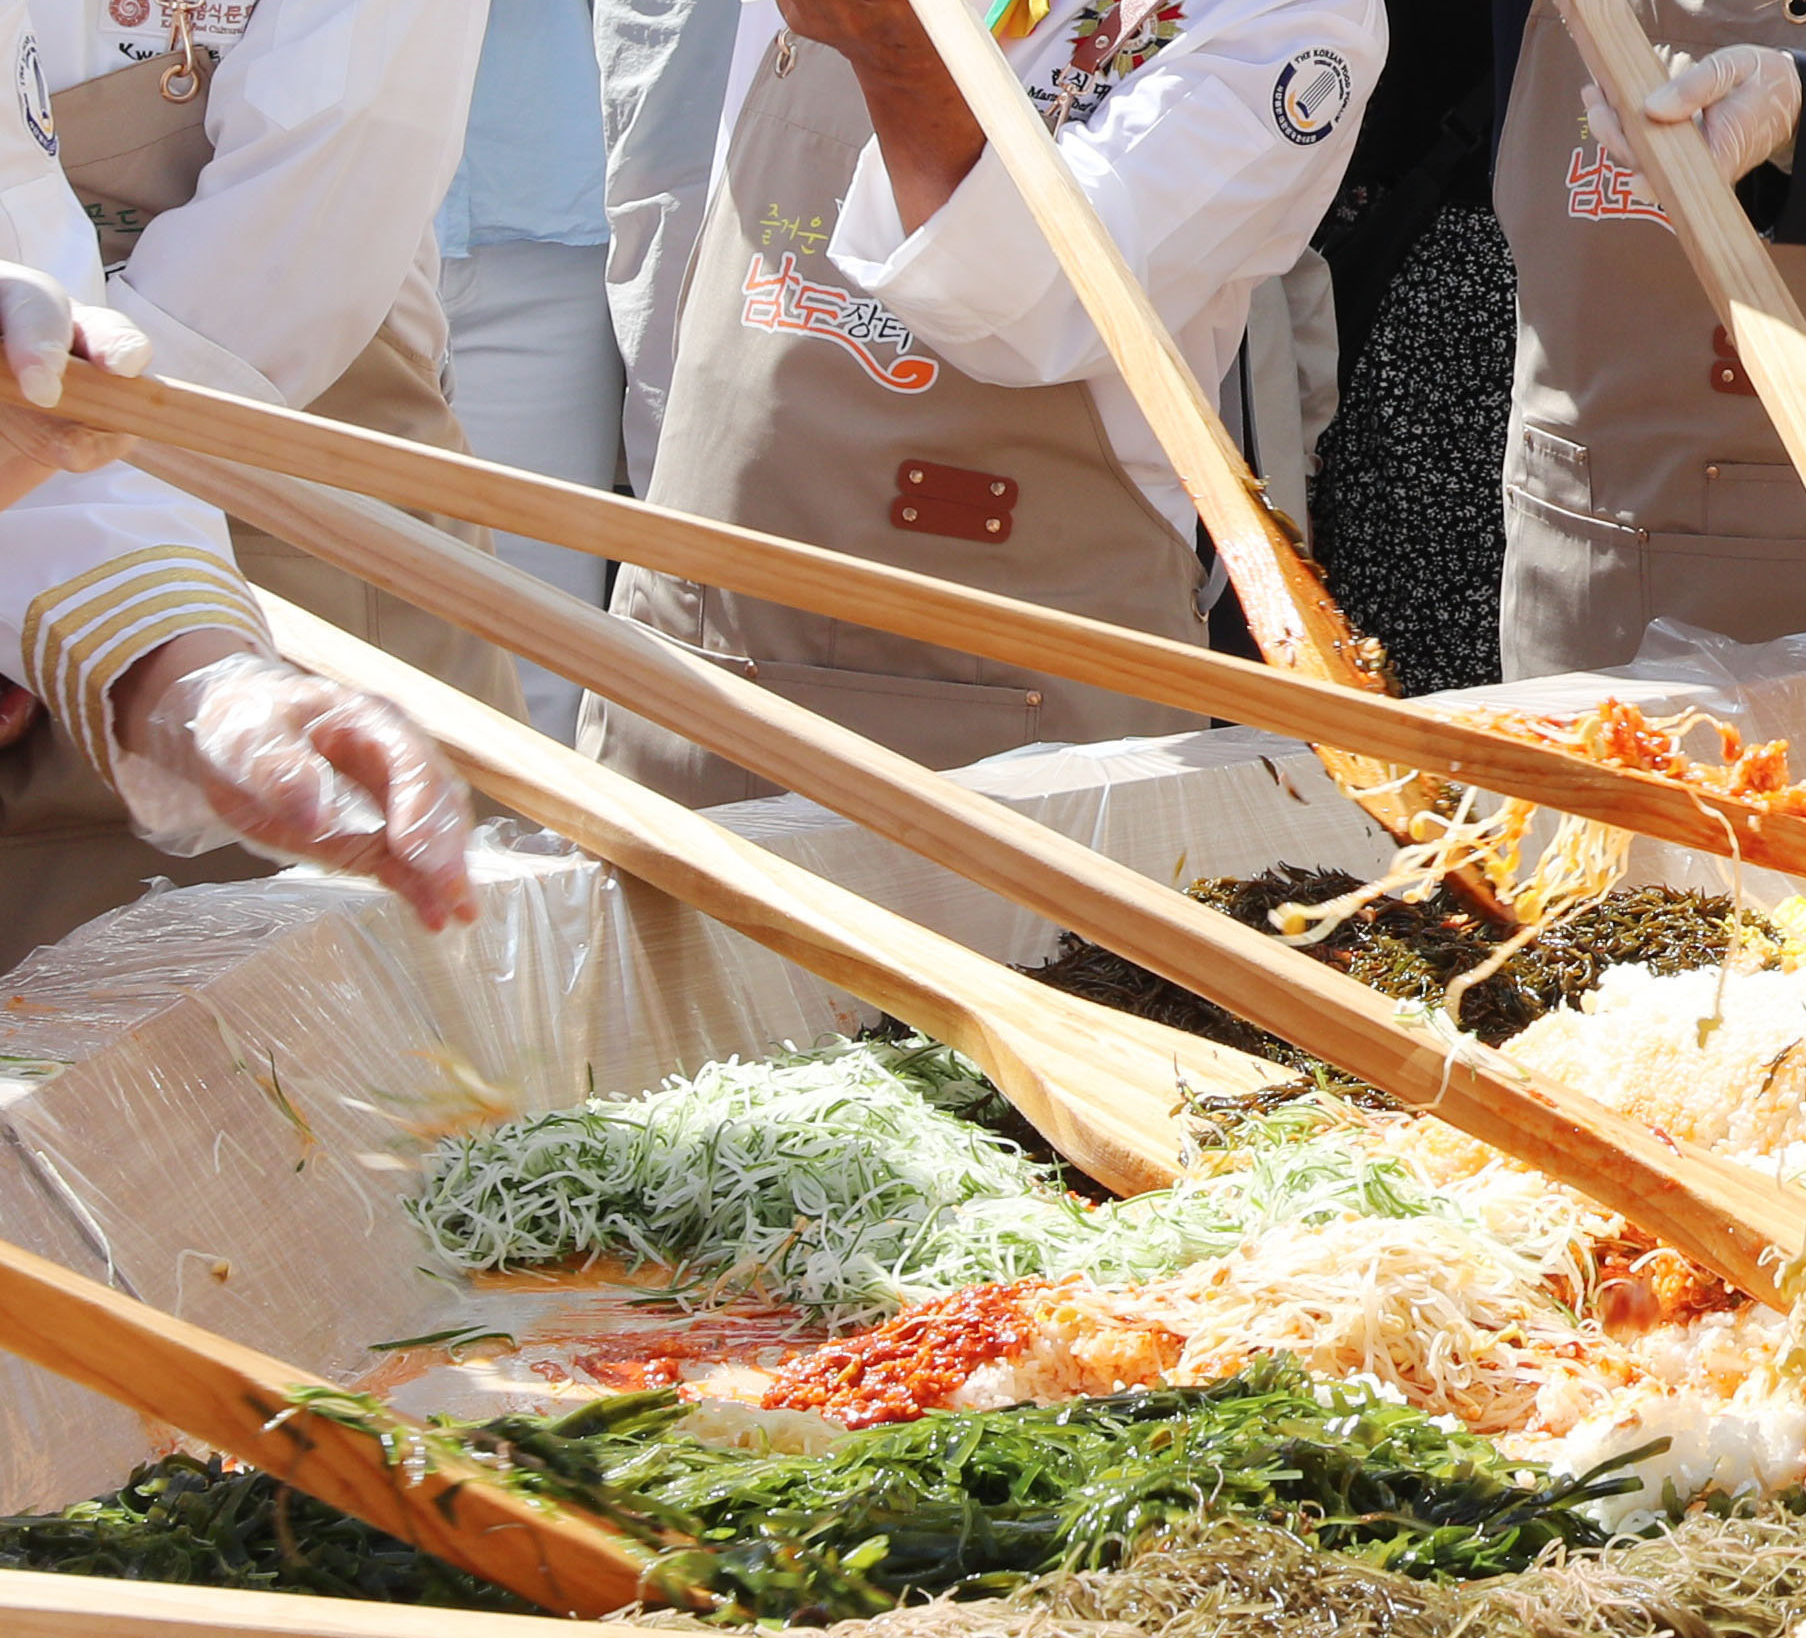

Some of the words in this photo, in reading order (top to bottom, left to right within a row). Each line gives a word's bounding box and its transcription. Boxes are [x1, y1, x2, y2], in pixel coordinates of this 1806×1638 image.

[84, 202, 144, 244] 푸드
[760, 203, 829, 255] 즐거운
[744, 256, 912, 354] 남도장터
